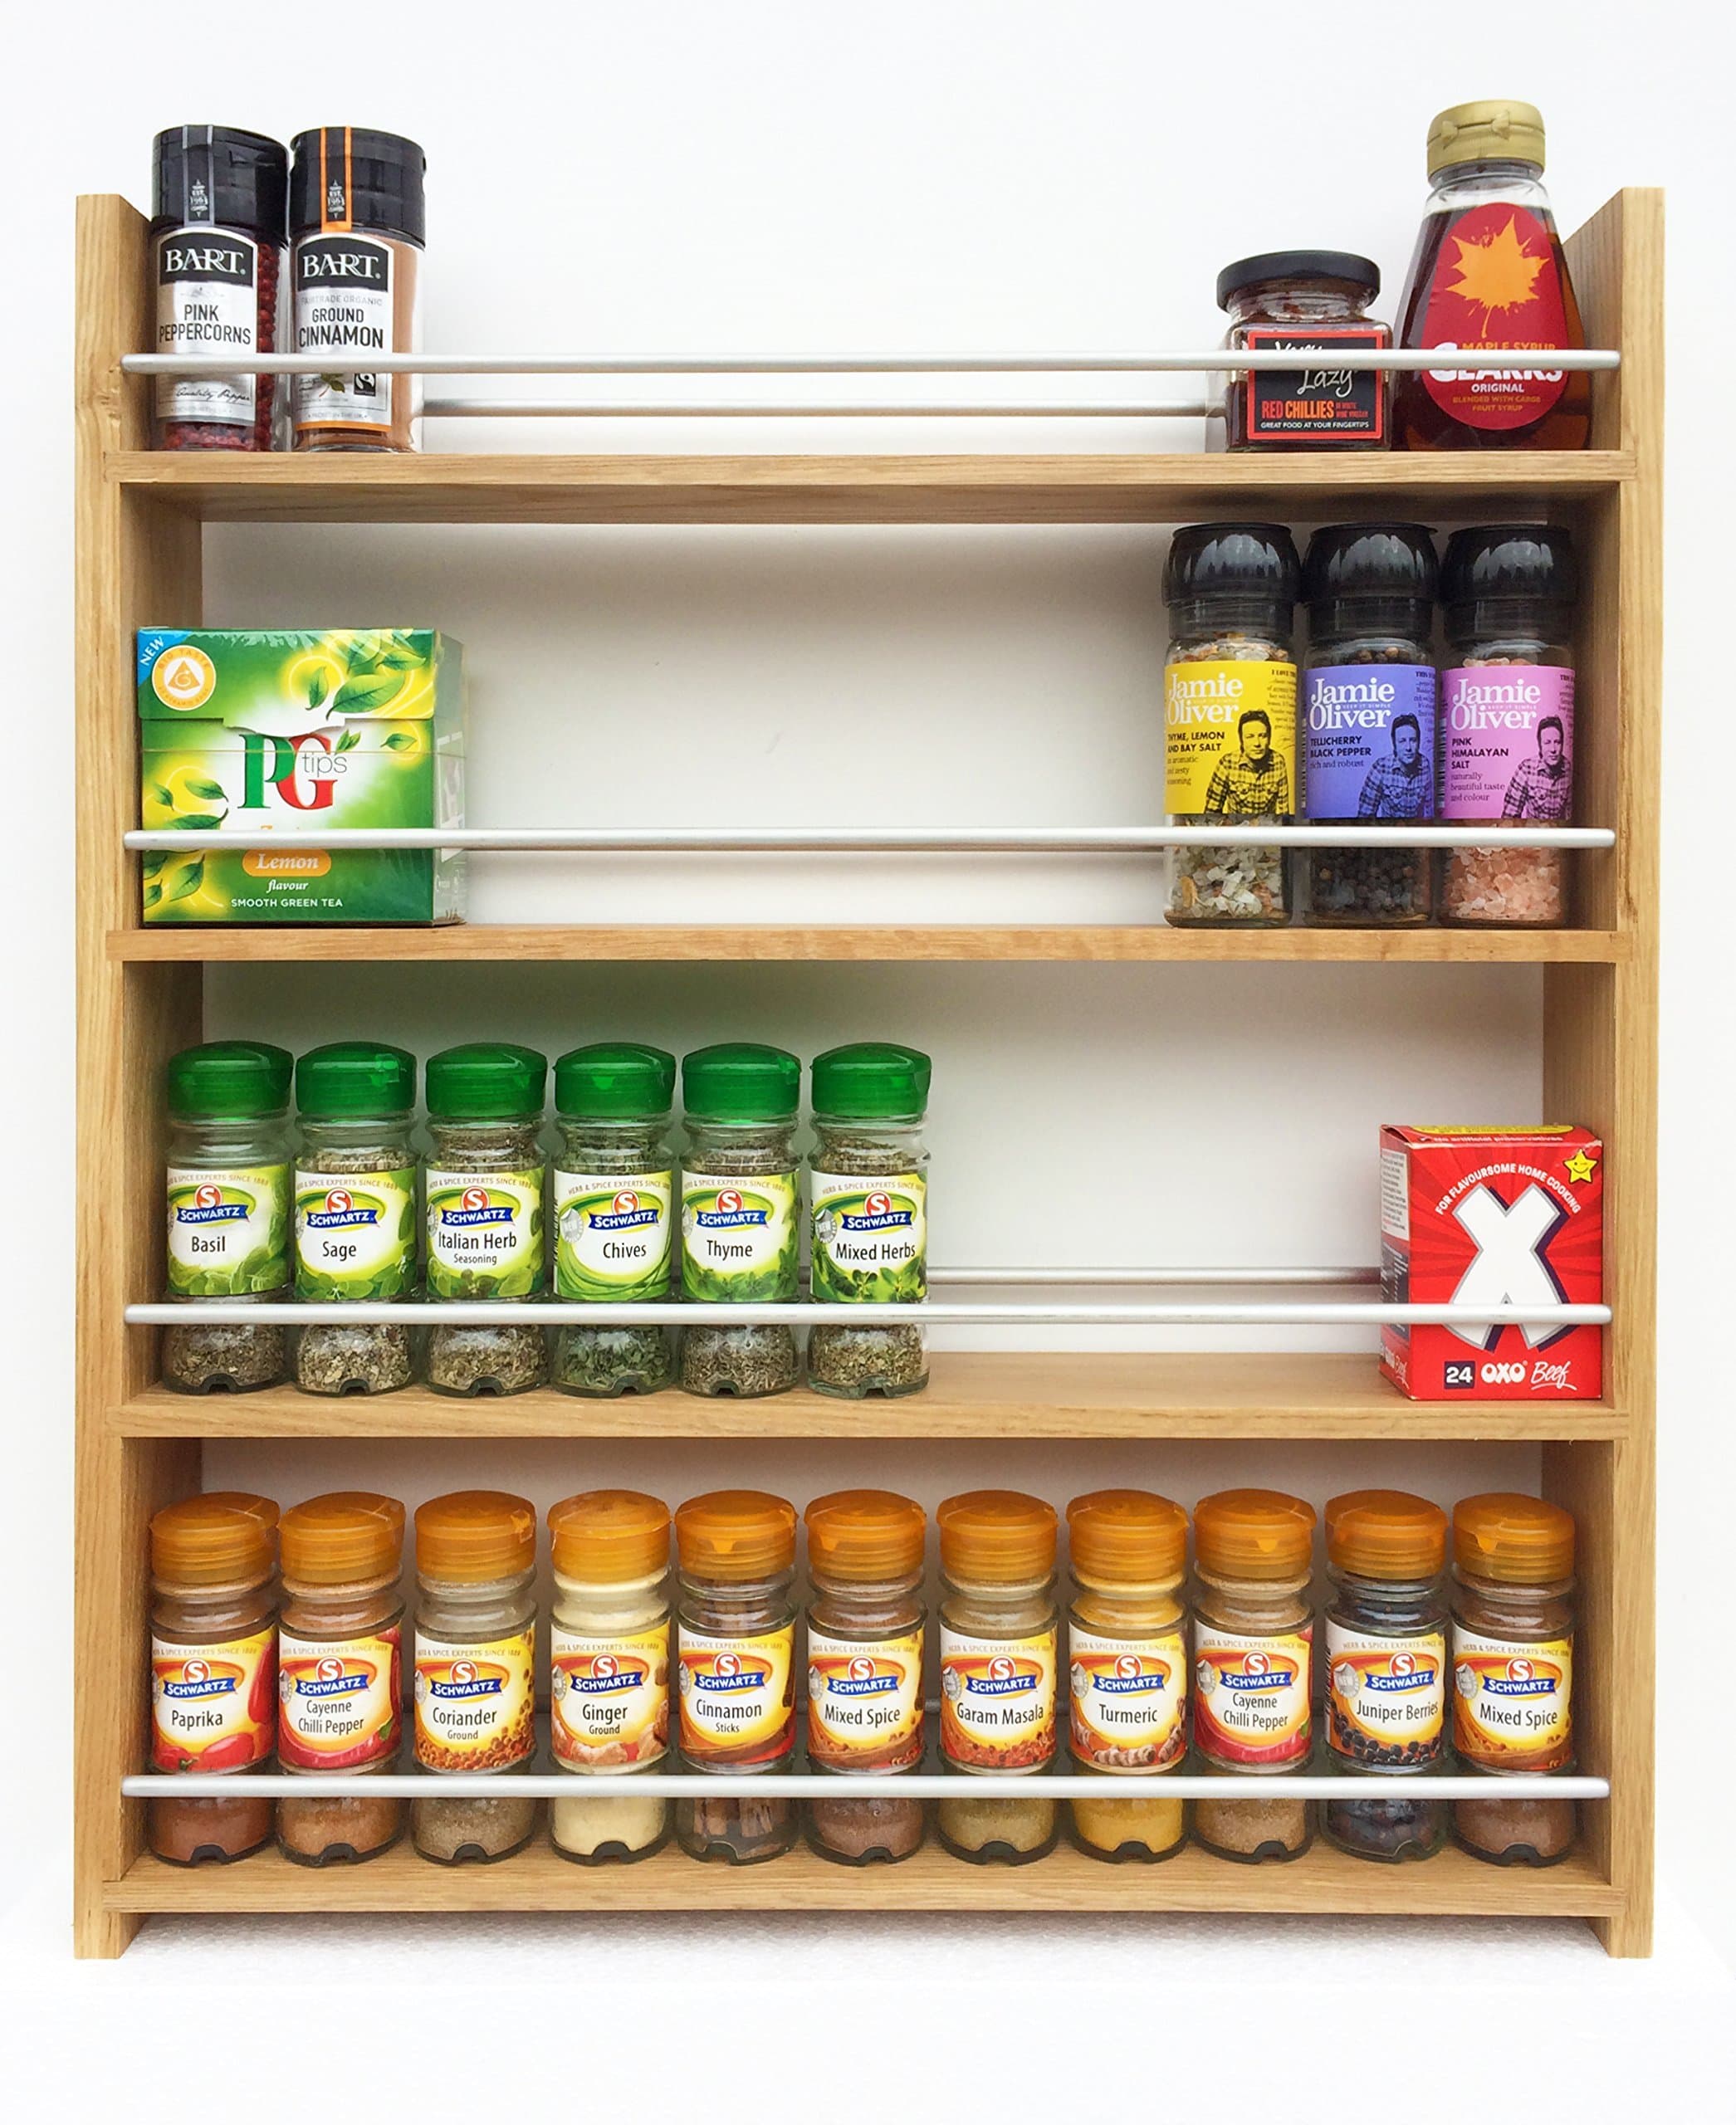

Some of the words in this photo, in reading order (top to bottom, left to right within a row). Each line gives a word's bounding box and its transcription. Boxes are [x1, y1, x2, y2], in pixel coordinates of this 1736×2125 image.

[165, 247, 244, 273] BART
[302, 253, 379, 279] BART
[184, 304, 219, 321] PINK
[311, 307, 364, 322] GROUND
[159, 323, 251, 344] PEPPERCORNS
[298, 325, 384, 349] CINNAMON
[1297, 369, 1352, 398] Lazy
[1471, 383, 1524, 393] ORIGINAL
[176, 387, 216, 399] Quality
[1453, 395, 1489, 403] BLENDED
[1491, 395, 1514, 403] WITH
[1261, 400, 1284, 419] RED
[1285, 400, 1334, 419] CHILLIES
[139, 636, 164, 667] NEW
[1169, 672, 1243, 700] Jamie
[1310, 677, 1396, 705] Jamie
[1452, 678, 1541, 706] Jamie
[1167, 699, 1240, 725] Oliver
[1309, 704, 1391, 730] Oliver
[1451, 704, 1537, 730] Oliver
[1191, 731, 1225, 740] LEMON
[1310, 735, 1362, 746] TELLICHERRY
[1452, 737, 1472, 746] PINK
[1181, 743, 1196, 753] BAY
[1199, 743, 1222, 751] SALT
[1310, 749, 1334, 758] BLACK
[1336, 747, 1372, 756] PEPPER
[1451, 748, 1509, 758] HIMALAYAN
[237, 733, 338, 810] PG
[301, 751, 347, 778] tips
[1337, 759, 1364, 768] robust
[1451, 760, 1470, 769] SALT
[1464, 793, 1490, 801] colour
[255, 853, 320, 870] Lemon
[266, 879, 309, 894] flavour
[231, 898, 277, 907] SMOOTH
[281, 898, 318, 907] GREEN
[321, 898, 344, 907] TEA
[591, 1181, 611, 1190] SPICE
[614, 1180, 643, 1188] EXPERTS
[844, 1181, 864, 1190] SPICE
[865, 1180, 896, 1189] EXPERTS
[1435, 1194, 1453, 1215] FOR
[1449, 1162, 1515, 1199] FLAVOURSOME
[1518, 1163, 1547, 1182] HOME
[1546, 1177, 1582, 1214] COOKING
[199, 1187, 216, 1208] S
[330, 1192, 348, 1213] S
[467, 1190, 484, 1211] S
[618, 1194, 634, 1215] S
[721, 1192, 738, 1213] S
[870, 1194, 887, 1215] S
[180, 1208, 240, 1221] SCHWARTZ
[310, 1211, 369, 1226] SCHWARTZ
[445, 1209, 506, 1224] SCHWARTZ
[594, 1211, 653, 1229] SCHWARTZ
[700, 1212, 760, 1225] SCHWARTZ
[847, 1213, 907, 1229] SCHWARTZ
[191, 1235, 226, 1253] Basil
[438, 1231, 479, 1249] Italian
[483, 1231, 517, 1249] Herb
[322, 1241, 357, 1262] Sage
[453, 1253, 497, 1266] Seasoning
[603, 1242, 647, 1259] Chives
[706, 1239, 753, 1262] Thyme
[835, 1242, 878, 1260] Mixed
[881, 1242, 917, 1260] Herbs
[1445, 1366, 1474, 1384] 24
[1480, 1362, 1526, 1385] OXO
[1530, 1360, 1571, 1390] Beef
[188, 1662, 204, 1683] S
[321, 1660, 339, 1682] S
[455, 1662, 472, 1683] S
[597, 1657, 614, 1678] S
[719, 1656, 736, 1677] S
[853, 1659, 871, 1681] S
[994, 1659, 1010, 1680] S
[1119, 1658, 1137, 1679] S
[1248, 1654, 1265, 1675] S
[1395, 1654, 1411, 1676] S
[1512, 1660, 1529, 1682] S
[167, 1681, 227, 1696] SCHWARTZ
[299, 1677, 361, 1694] SCHWARTZ
[434, 1681, 495, 1696] SCHWARTZ
[575, 1673, 636, 1690] SCHWARTZ
[698, 1674, 758, 1688] SCHWARTZ
[831, 1678, 892, 1693] SCHWARTZ
[971, 1677, 1030, 1693] SCHWARTZ
[1098, 1677, 1158, 1691] SCHWARTZ
[1225, 1673, 1286, 1688] SCHWARTZ
[1371, 1673, 1430, 1689] SCHWARTZ
[1488, 1679, 1550, 1693] SCHWARTZ
[306, 1699, 353, 1717] Cayenne
[696, 1698, 762, 1719] Cinnamon
[1232, 1693, 1279, 1711] Cayenne
[433, 1707, 497, 1726] Coriander
[582, 1703, 628, 1725] Ginger
[824, 1703, 863, 1725] Mixed
[866, 1707, 901, 1728] Spice
[956, 1702, 998, 1725] Garam
[1001, 1703, 1044, 1725] Masala
[1098, 1703, 1158, 1724] Turmeric
[1356, 1699, 1403, 1724] Juniper
[1406, 1701, 1439, 1721] Berries
[1479, 1702, 1522, 1726] Mixed
[1525, 1709, 1558, 1731] Spice
[171, 1710, 223, 1732] Paprika
[298, 1717, 323, 1733] Chilli
[325, 1718, 364, 1736] Pepper
[589, 1724, 621, 1735] Ground
[715, 1722, 741, 1733] Sticks
[1223, 1710, 1250, 1727] Chilli
[1252, 1714, 1289, 1732] Pepper
[447, 1729, 479, 1740] Ground
